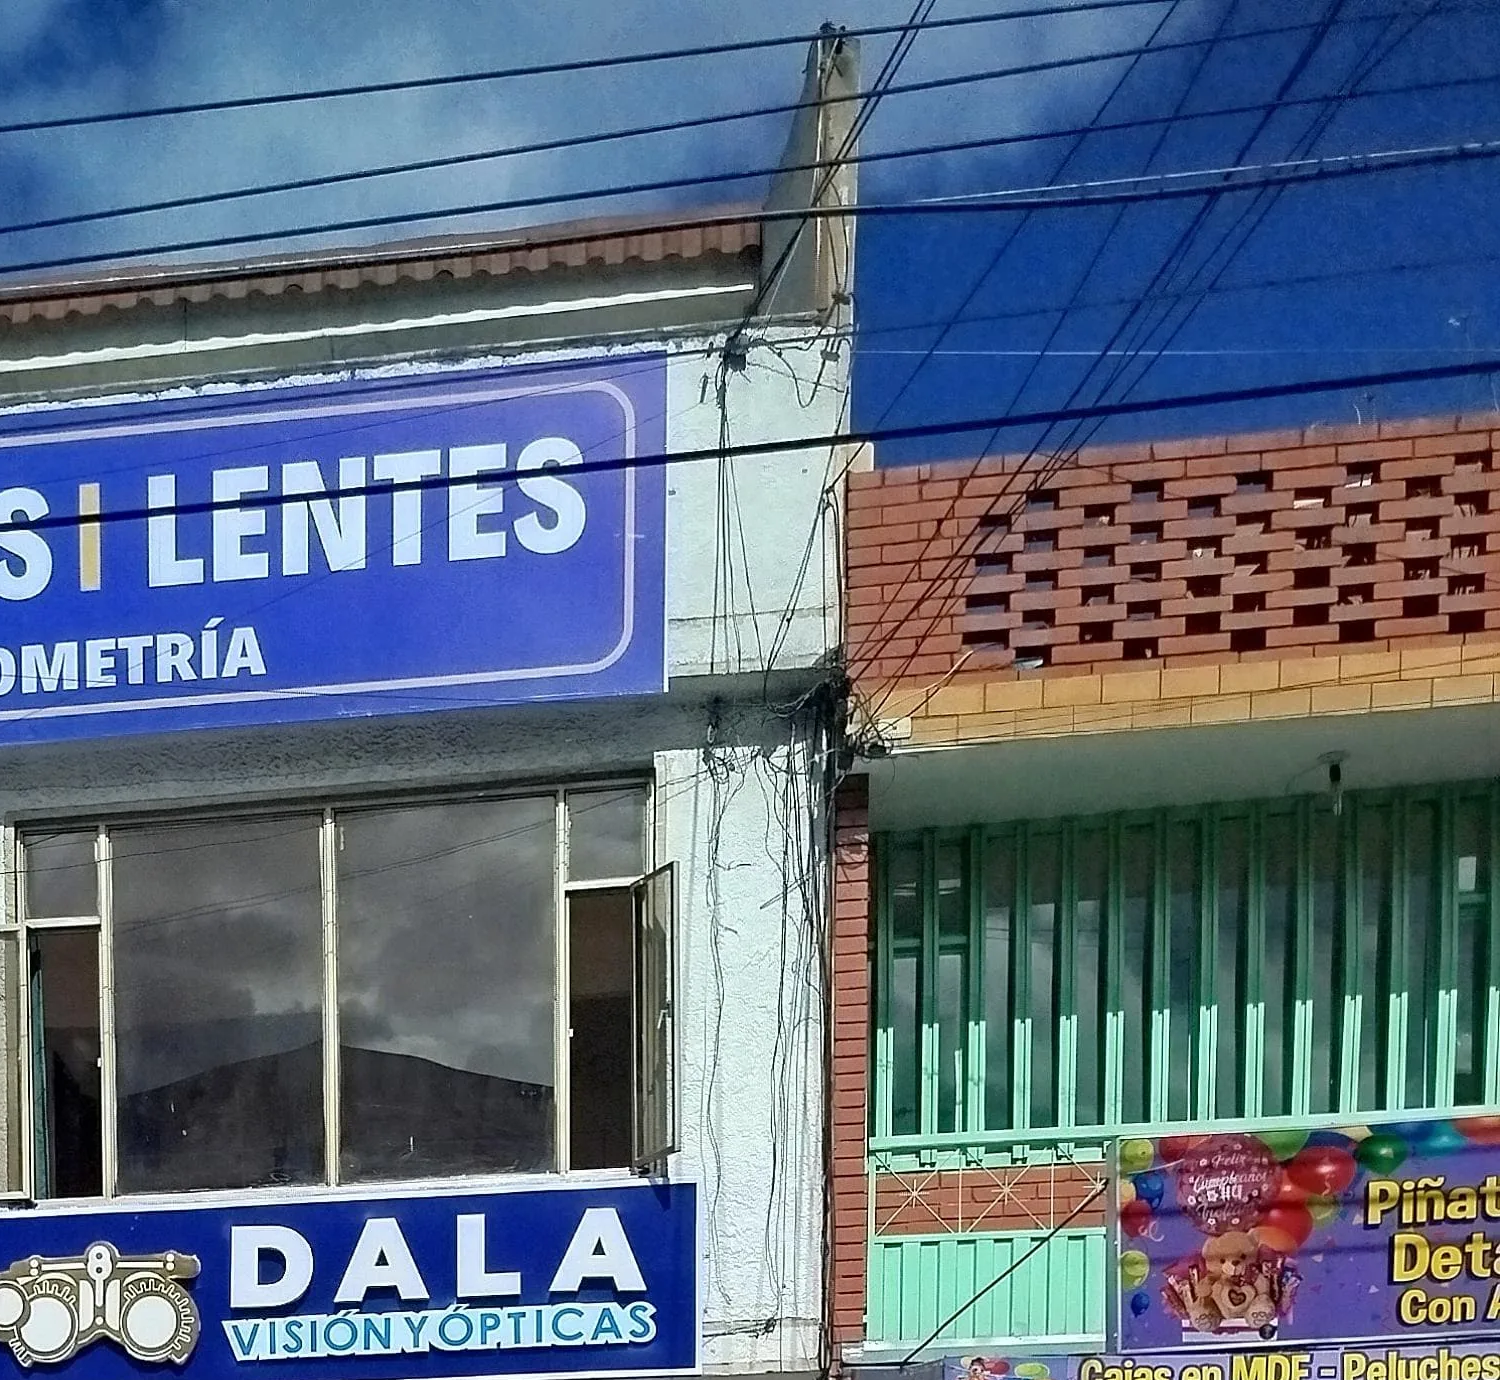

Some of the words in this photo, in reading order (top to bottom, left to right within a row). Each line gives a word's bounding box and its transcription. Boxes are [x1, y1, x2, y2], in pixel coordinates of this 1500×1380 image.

[146, 436, 587, 587] LENTES
[230, 1207, 648, 1310] DALA
[1392, 1232, 1500, 1282] Det
[438, 1304, 652, 1348] ÓPTICAS
[1400, 1288, 1476, 1325] Con
